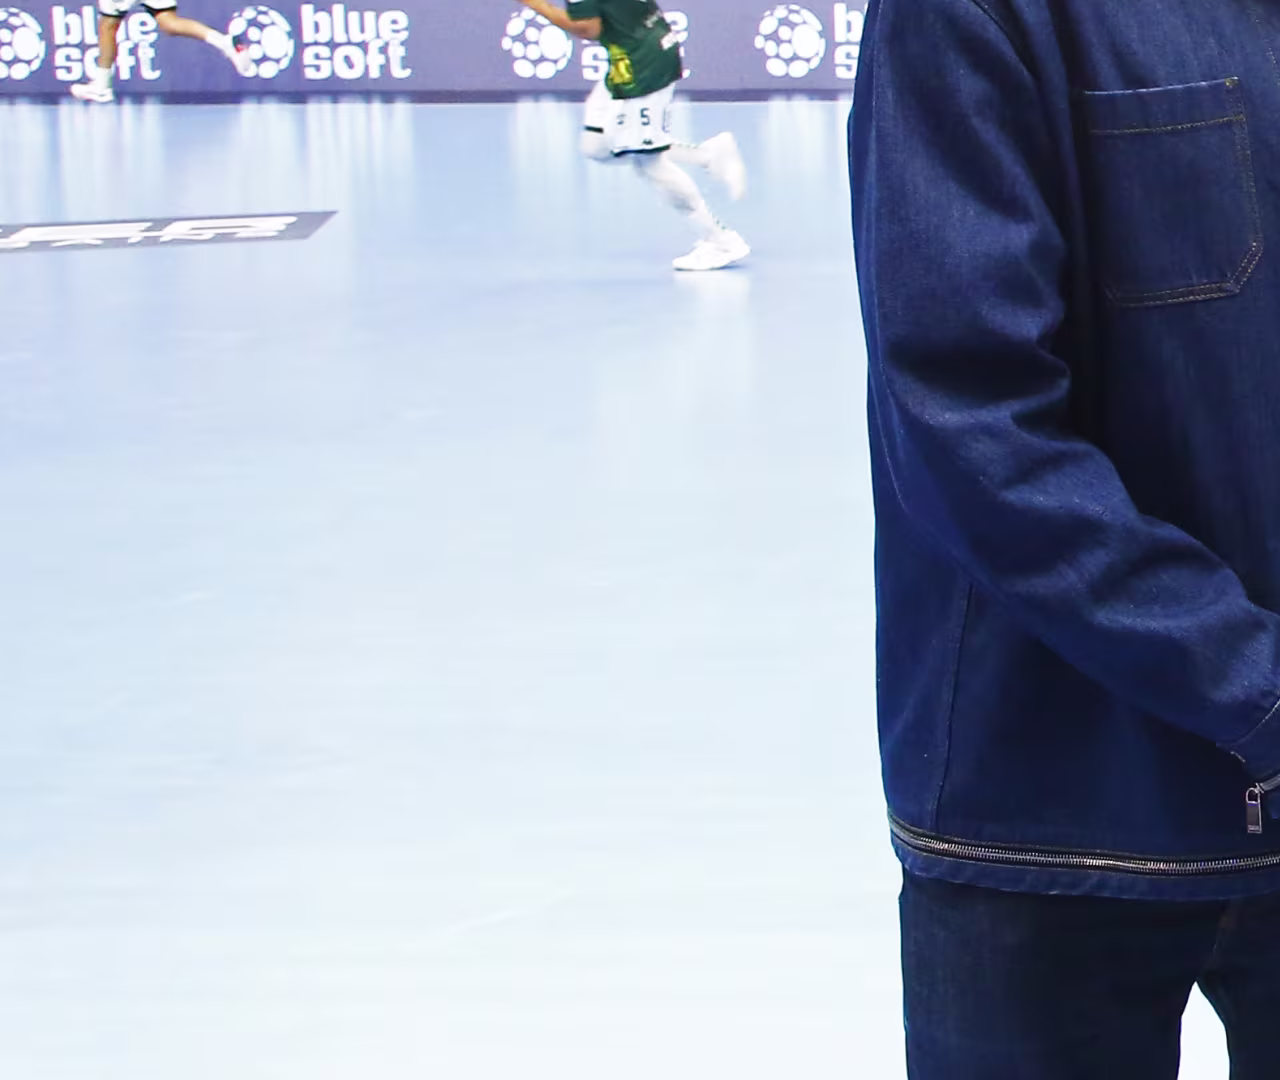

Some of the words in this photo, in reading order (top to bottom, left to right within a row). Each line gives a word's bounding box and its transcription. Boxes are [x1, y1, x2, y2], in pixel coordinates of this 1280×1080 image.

[301, 4, 409, 43] blue
[302, 39, 412, 79] soft
[640, 107, 650, 126] 5
